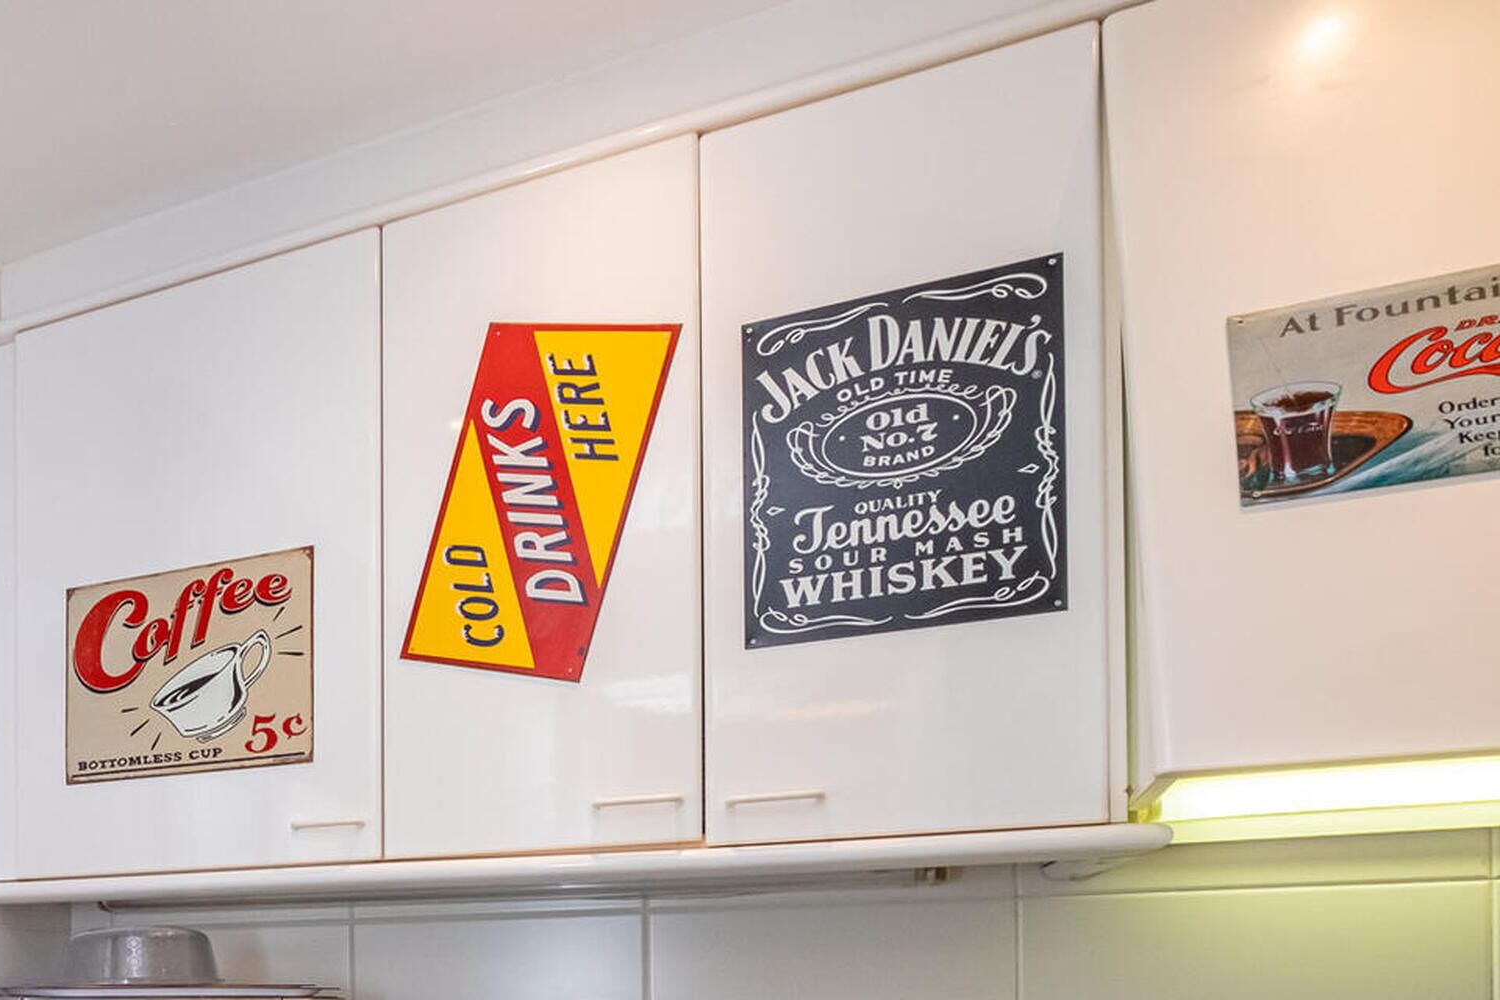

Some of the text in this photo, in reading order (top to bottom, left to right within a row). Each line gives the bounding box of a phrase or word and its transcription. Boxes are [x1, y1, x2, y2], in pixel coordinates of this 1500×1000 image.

[1279, 312, 1322, 338] At
[1454, 314, 1500, 332] DR
[756, 314, 1053, 424] JACK DANIEL'S
[836, 368, 954, 402] OLD TIME
[547, 352, 620, 462] HERE
[865, 402, 931, 431] Old
[1438, 397, 1500, 415] Order
[1443, 413, 1500, 430] Your
[1458, 430, 1500, 444] Kee
[862, 445, 935, 467] BRAND
[480, 398, 589, 608] DRINKS
[854, 489, 943, 515] QUALITY
[792, 494, 1016, 555] Tennessee
[788, 526, 1024, 575] SOUR MASH
[779, 545, 1029, 609] WHISKEY
[443, 544, 505, 648] COLD
[74, 567, 293, 694] Coffee
[77, 747, 223, 772] BOTTOMLESS CUP
